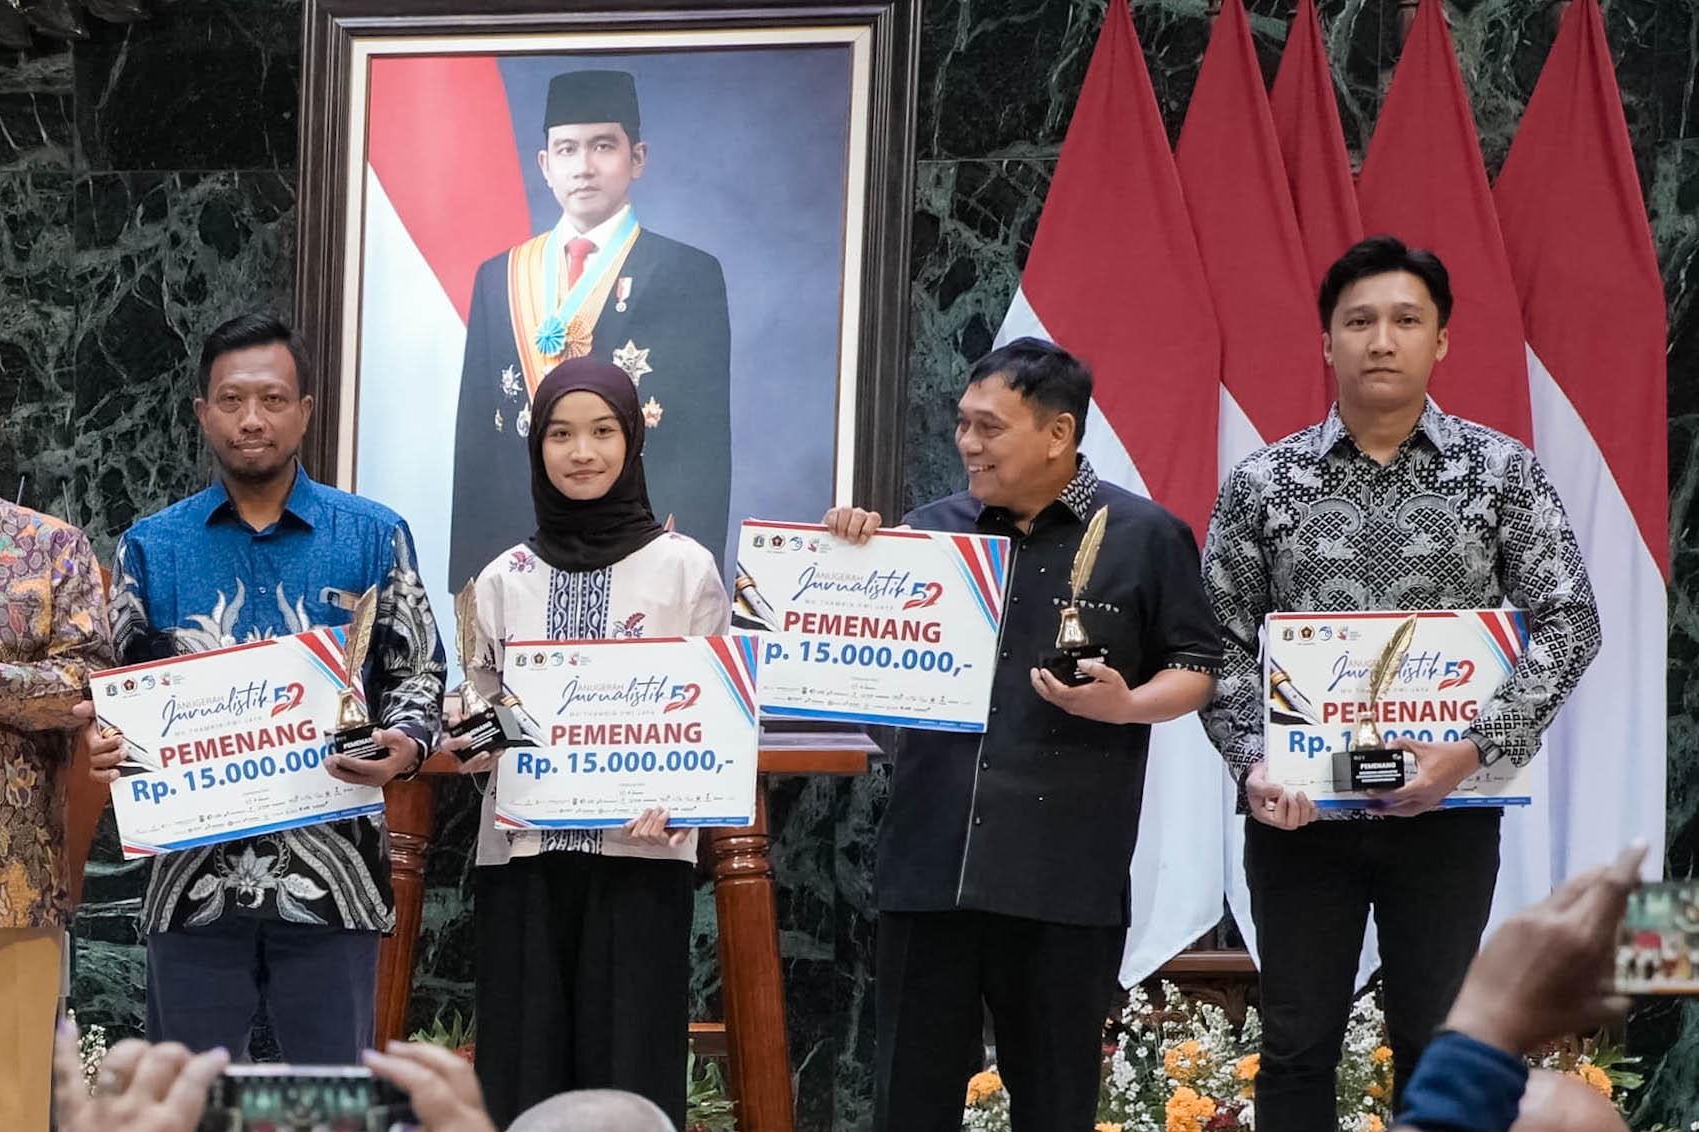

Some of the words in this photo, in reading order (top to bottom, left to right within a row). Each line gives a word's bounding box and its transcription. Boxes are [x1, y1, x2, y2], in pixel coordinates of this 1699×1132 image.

[791, 562, 910, 601] Jurnalistik
[902, 581, 943, 610] 52
[783, 611, 941, 644] PEMENANG
[765, 642, 789, 665] p.
[800, 640, 973, 677] 15.000.000,-
[1327, 651, 1440, 692] Jurlistik
[1438, 660, 1475, 691] 52
[161, 680, 268, 738] Jurnalistik
[271, 682, 305, 718] 52
[557, 675, 668, 715] Jurnalistik
[663, 683, 701, 714] 52
[159, 719, 317, 769] PEMENANG
[551, 722, 702, 746] PEMENANG
[1289, 731, 1332, 759] Rp.
[517, 753, 558, 779] Rp.
[568, 750, 734, 774] 15.000.000,-
[131, 778, 177, 805] Rp.
